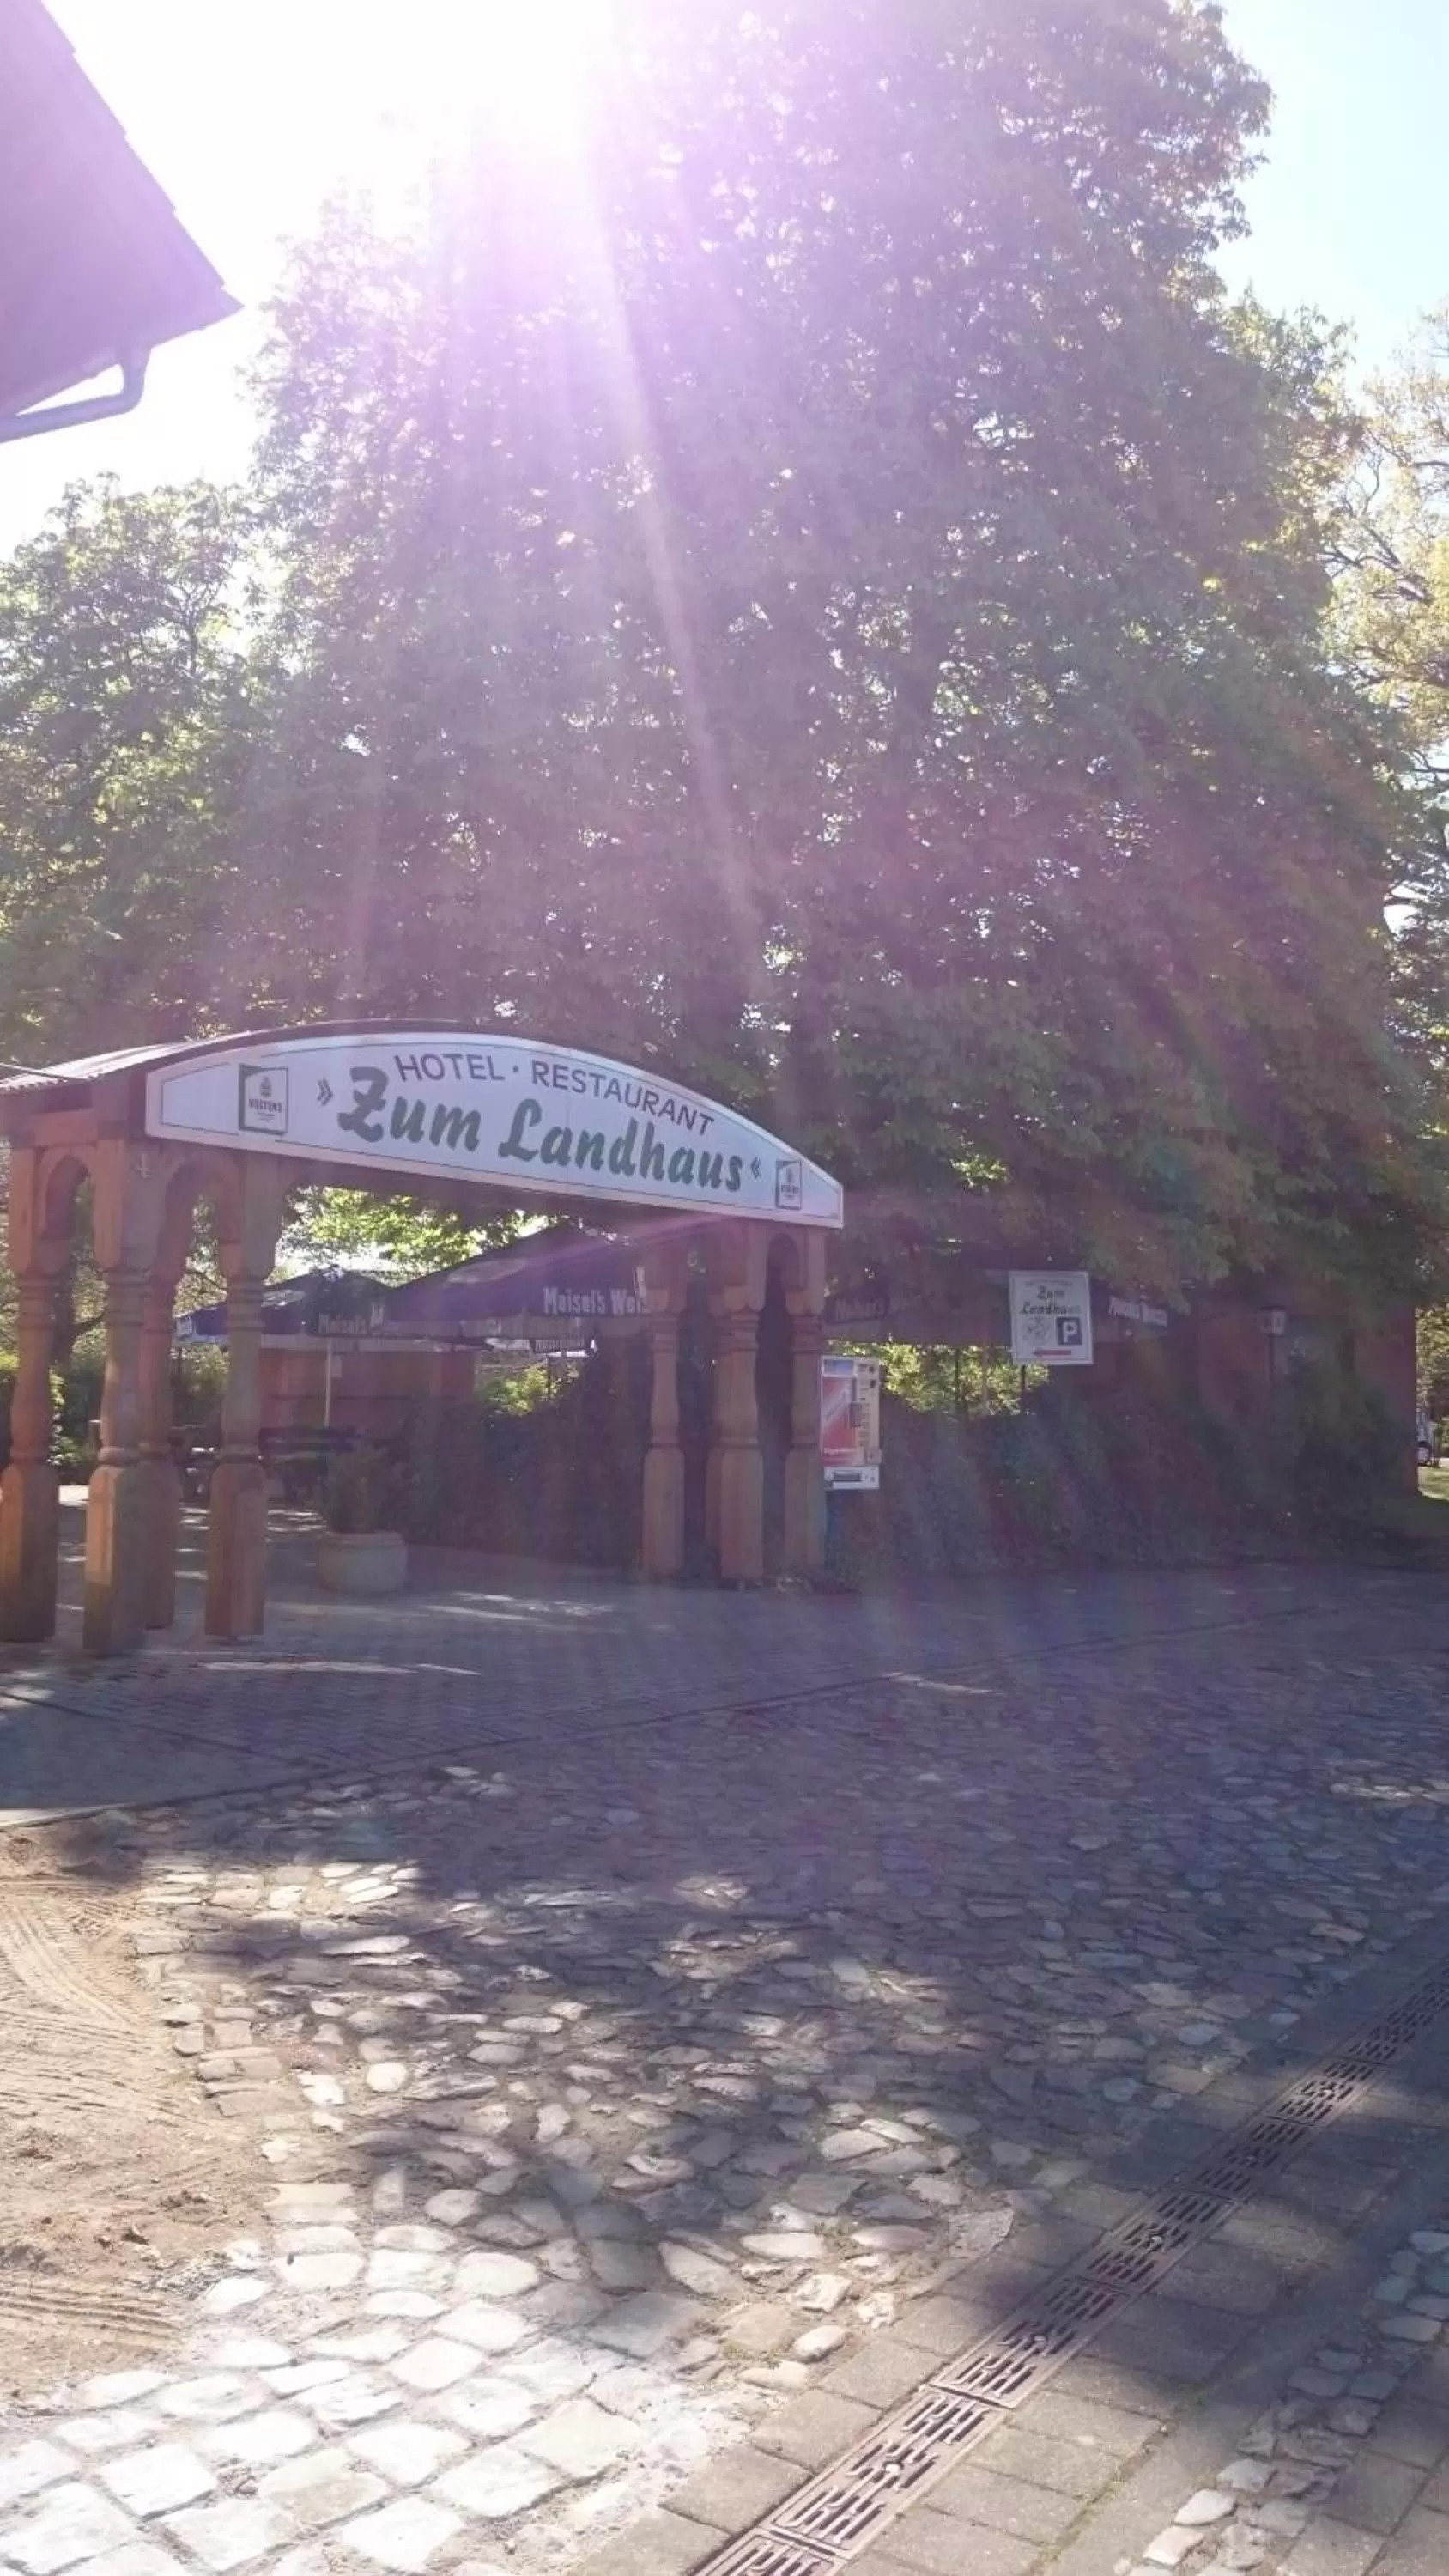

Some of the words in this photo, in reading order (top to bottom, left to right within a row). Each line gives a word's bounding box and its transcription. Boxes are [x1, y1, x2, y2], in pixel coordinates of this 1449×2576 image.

[394, 1053, 504, 1082] HOTEL
[531, 1060, 714, 1137] RESTAURANT
[1062, 1321, 1078, 1343] P
